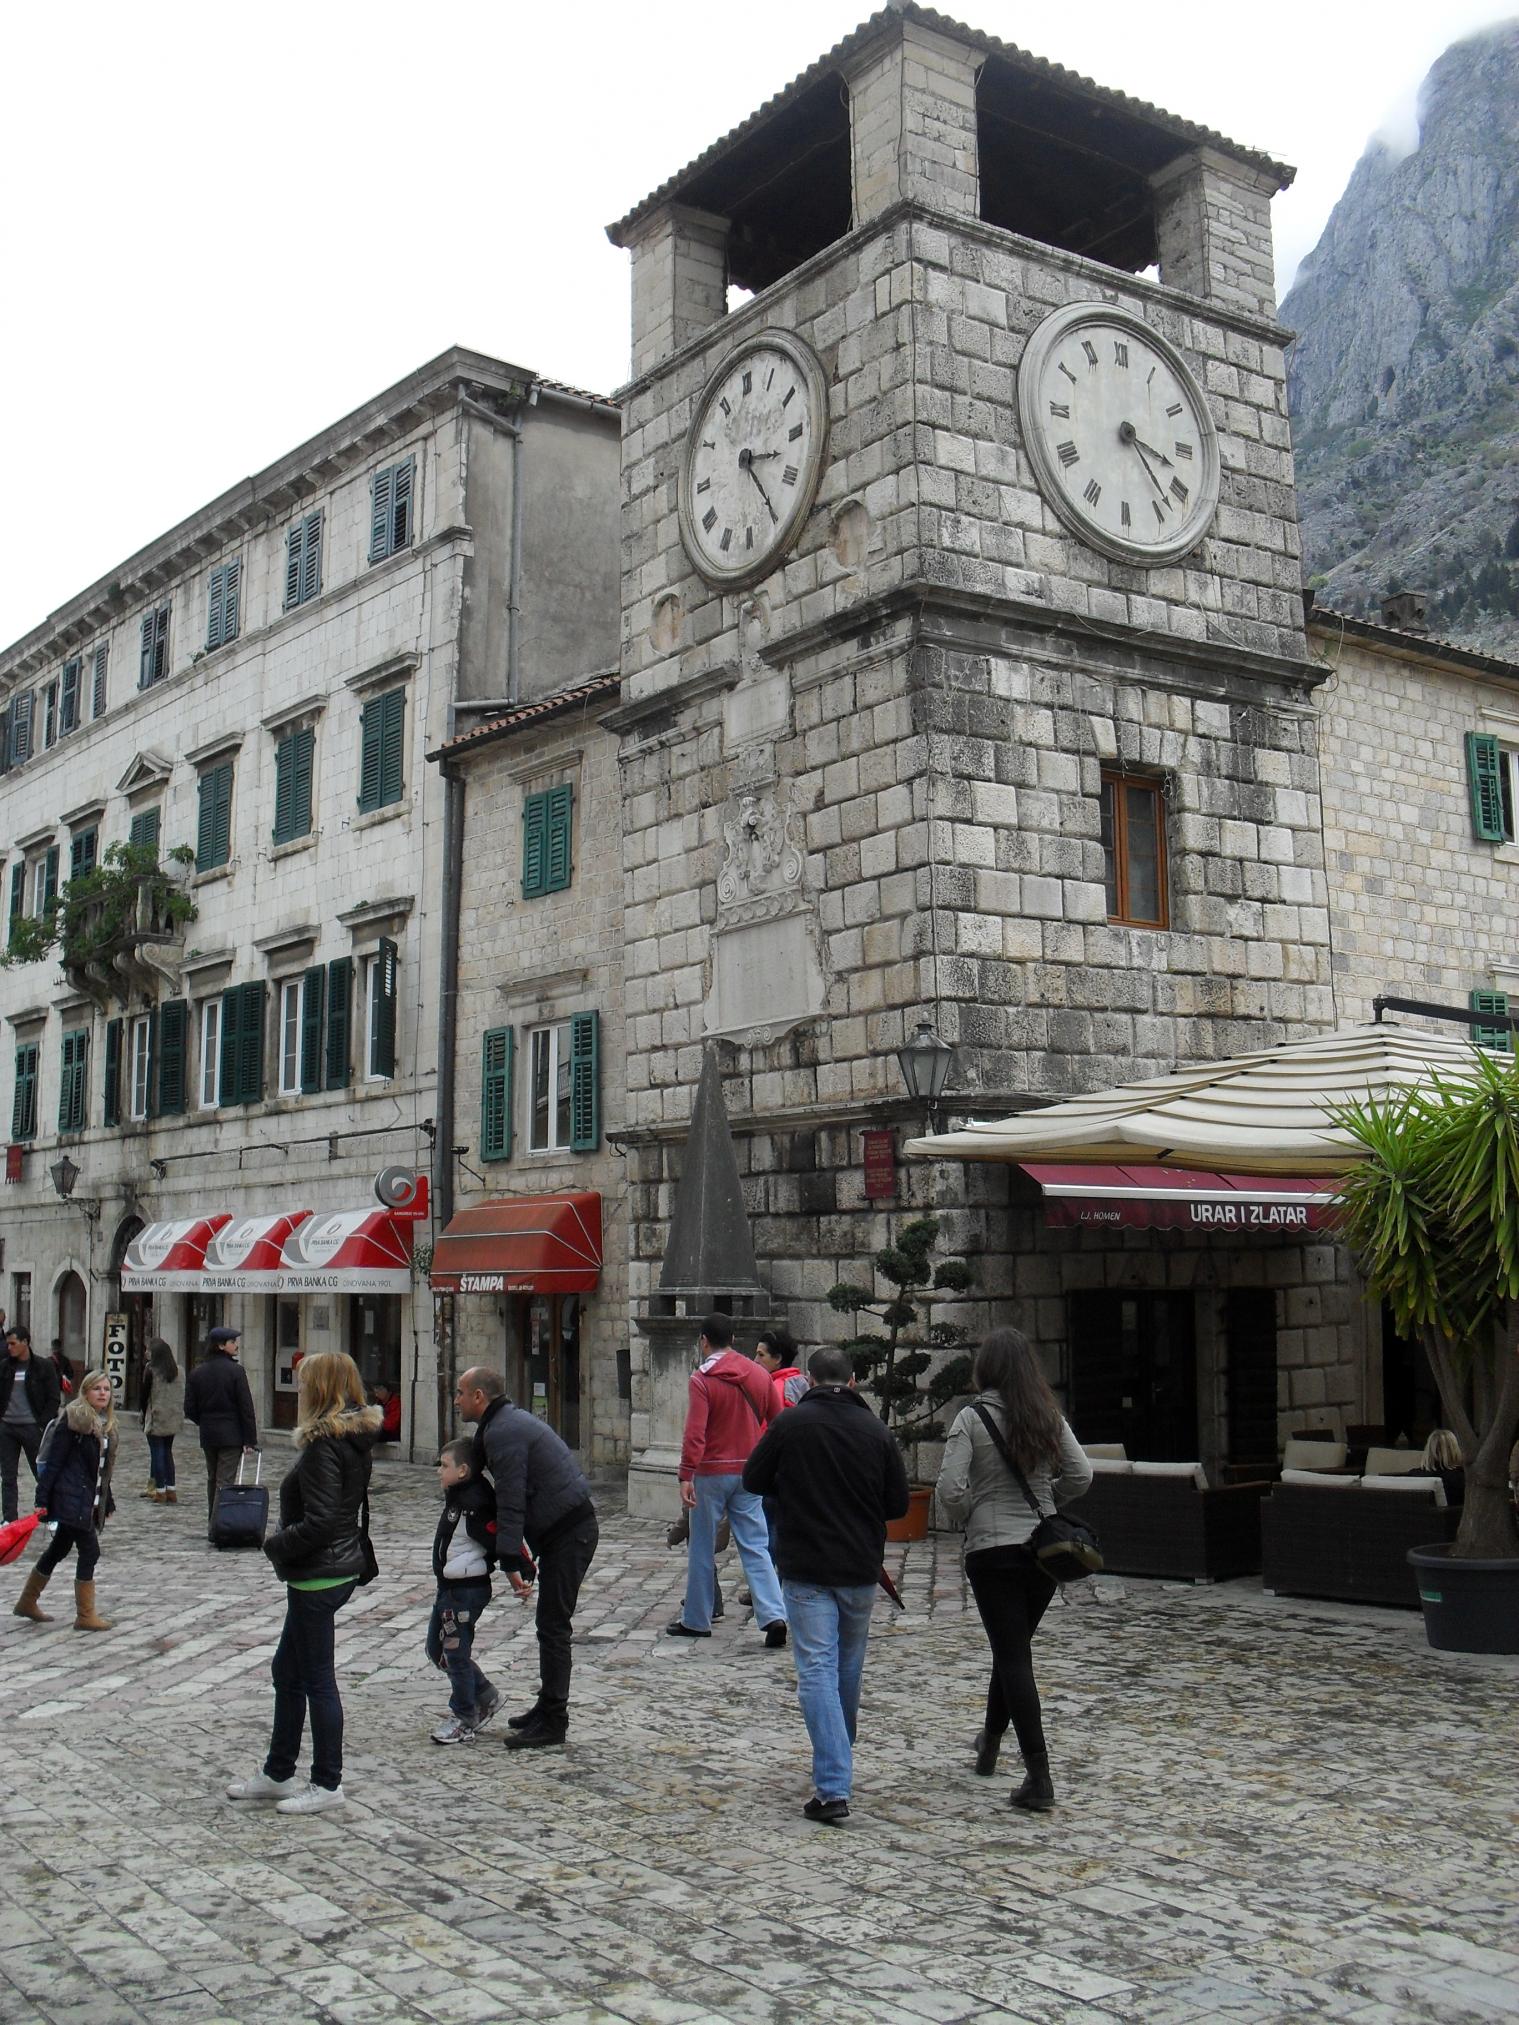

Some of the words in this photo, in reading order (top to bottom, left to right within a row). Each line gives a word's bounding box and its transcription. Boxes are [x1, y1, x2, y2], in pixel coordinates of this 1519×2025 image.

[1114, 341, 1129, 369] XII
[1058, 362, 1077, 385] X
[1166, 403, 1183, 418] II
[702, 440, 716, 450] X
[1190, 1204, 1237, 1223] URAR
[1241, 1207, 1246, 1223] I
[1250, 1206, 1308, 1224] ZLATAR
[128, 1277, 141, 1287] PRVA
[140, 1277, 158, 1287] BANKA
[158, 1277, 167, 1287] CG
[202, 1277, 217, 1288] PRVA
[217, 1277, 236, 1288] BANKA
[236, 1277, 246, 1288] CG
[287, 1276, 303, 1287] PRVA
[304, 1276, 327, 1287] BANKA
[328, 1276, 338, 1287] CG
[460, 1274, 504, 1292] ŠTAMPA
[107, 1324, 126, 1389] FOTO
